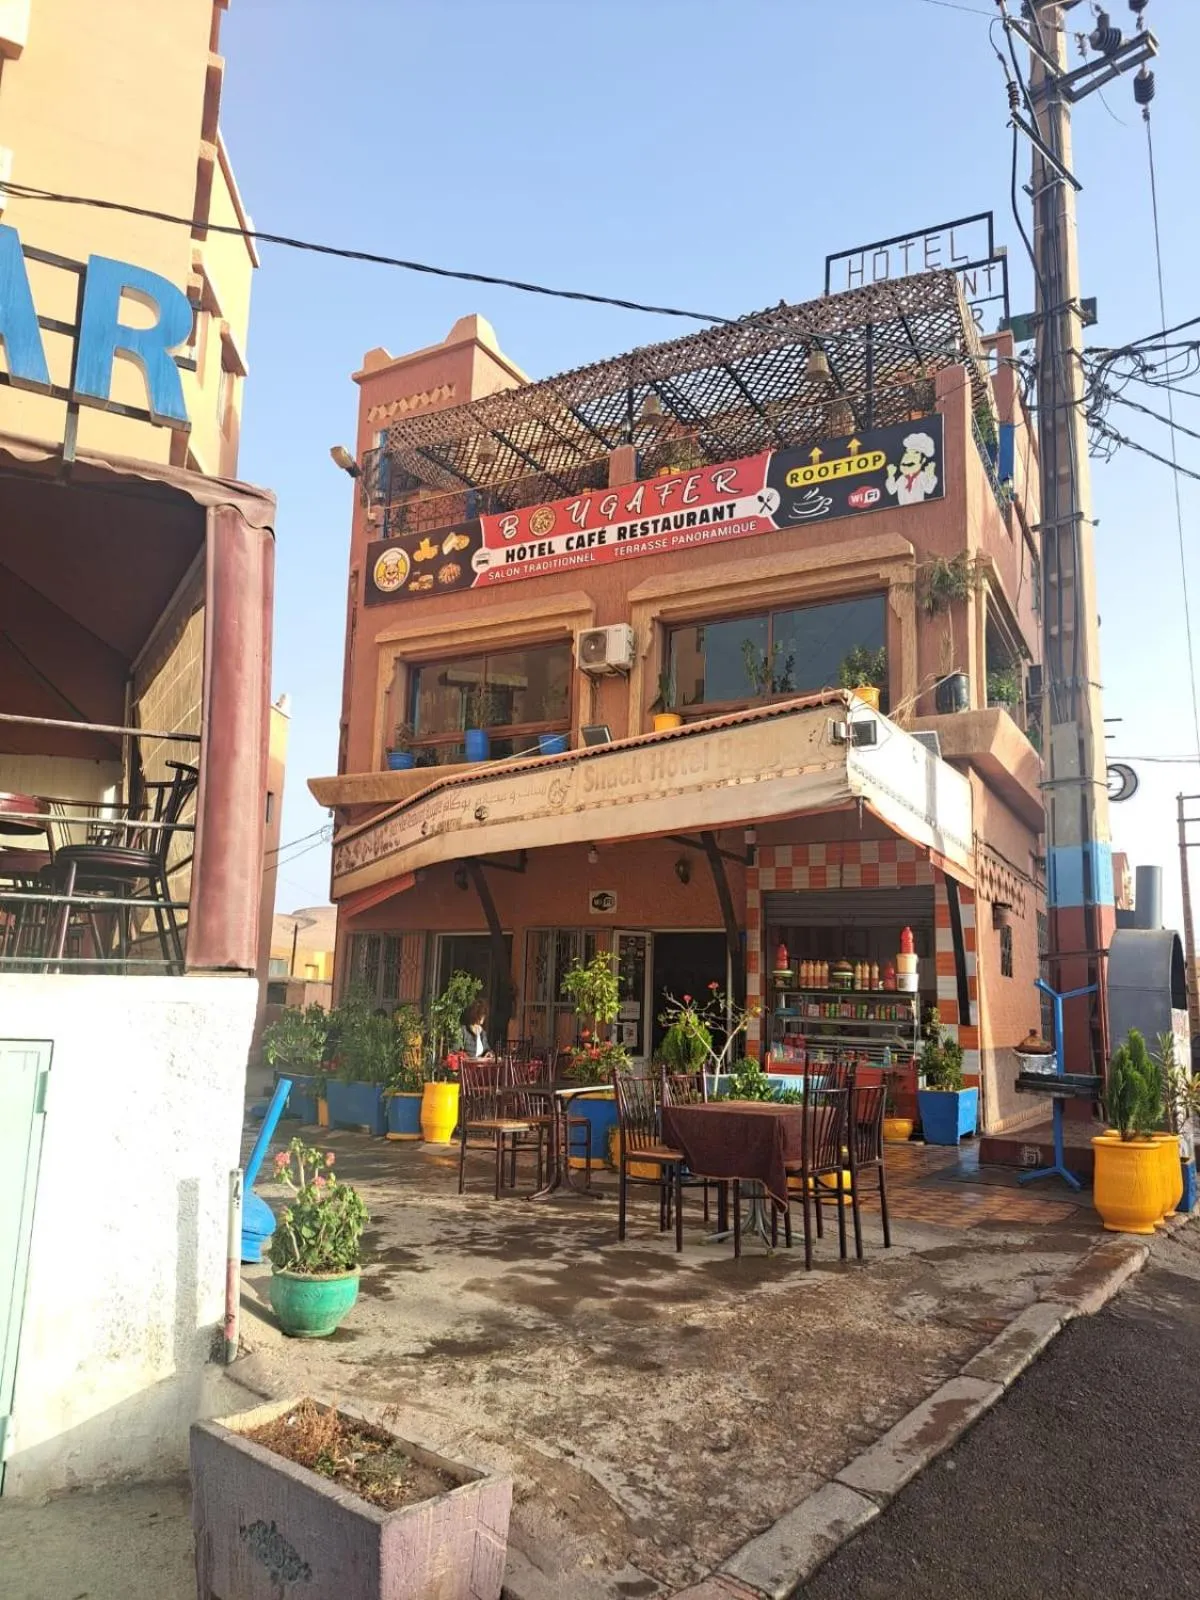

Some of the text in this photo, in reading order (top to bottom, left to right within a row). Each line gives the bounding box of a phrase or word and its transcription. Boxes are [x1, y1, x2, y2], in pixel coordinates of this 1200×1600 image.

[848, 231, 969, 288] HOTEL
[790, 454, 883, 483] ROOFTOP
[488, 521, 757, 581] SALON TRADITIONNEL TERRASSE PANORAMIQUE
[505, 503, 737, 563] HÔTEL CAFÉ RESTAURANT
